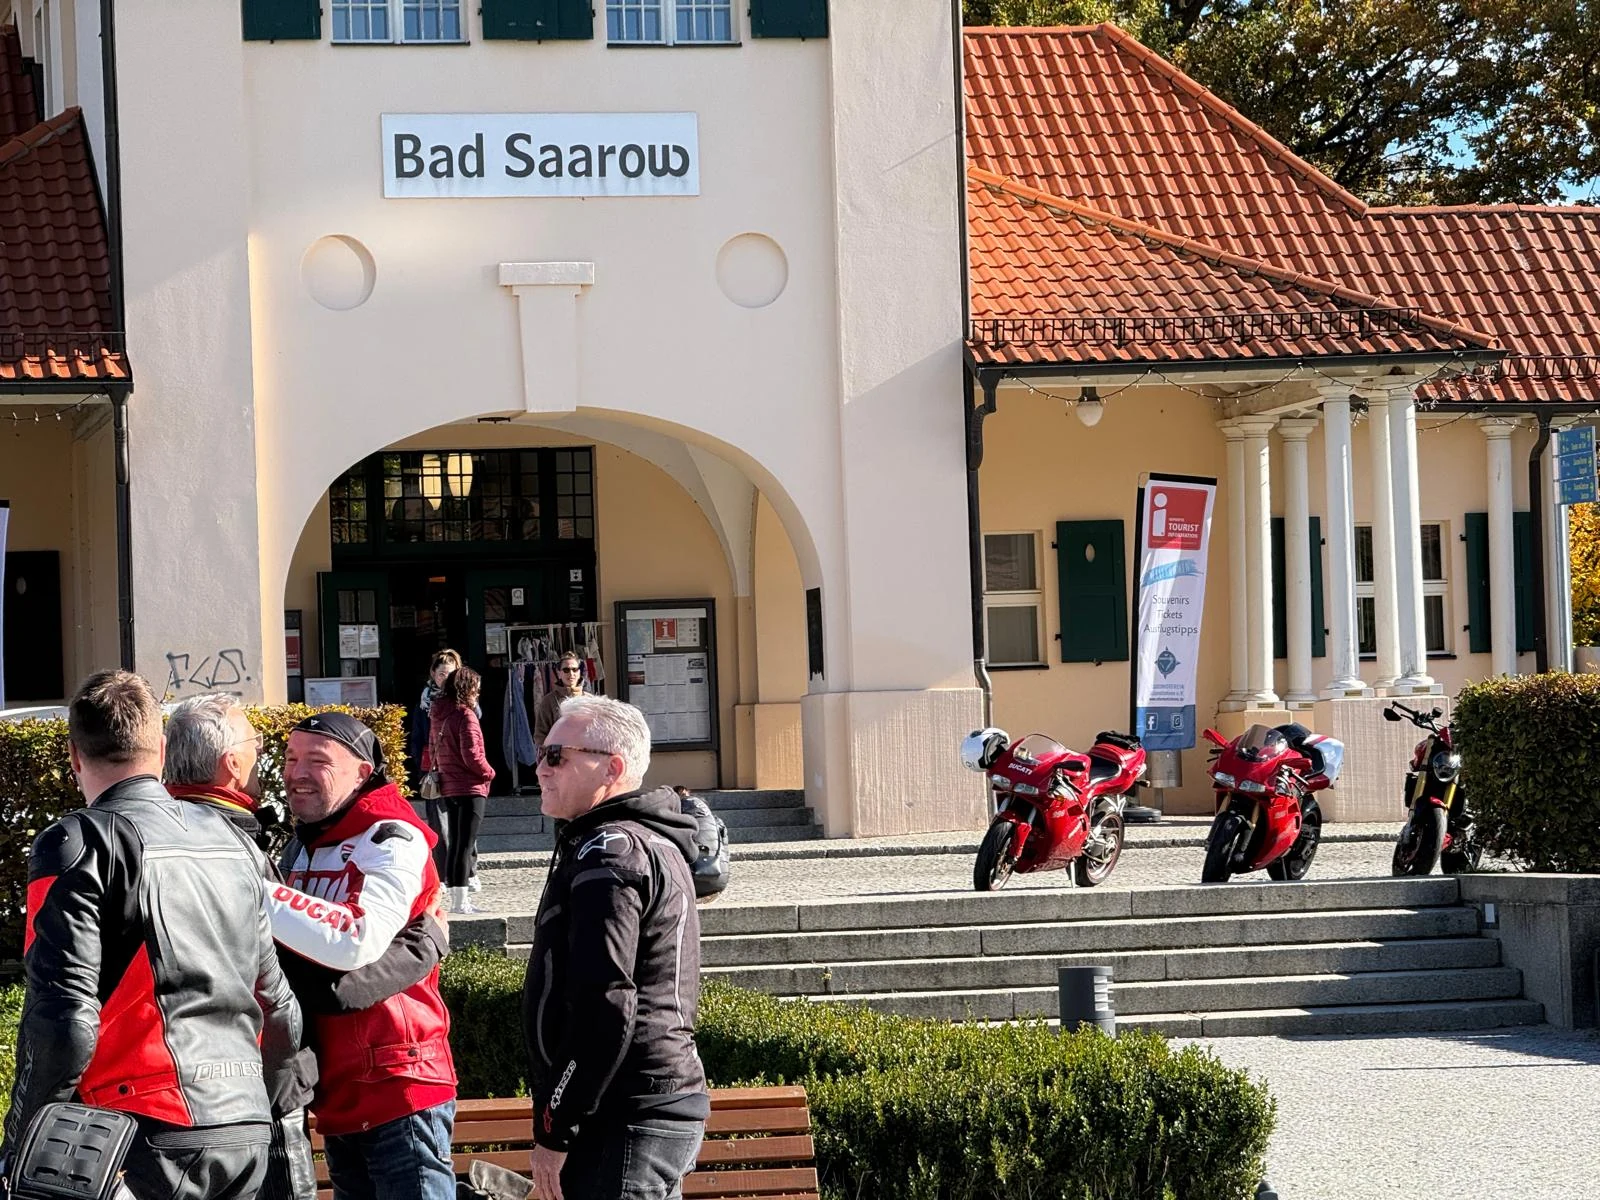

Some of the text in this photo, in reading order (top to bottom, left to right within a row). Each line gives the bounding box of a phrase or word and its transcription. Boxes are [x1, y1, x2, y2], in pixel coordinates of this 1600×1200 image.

[394, 132, 690, 178] Bad Saarow
[1168, 523, 1200, 532] TOURIST
[1152, 595, 1190, 605] Souvenirs
[1156, 608, 1183, 619] Tickets
[1144, 622, 1198, 636] Ausflugstipps
[1008, 762, 1033, 776] DUCATI
